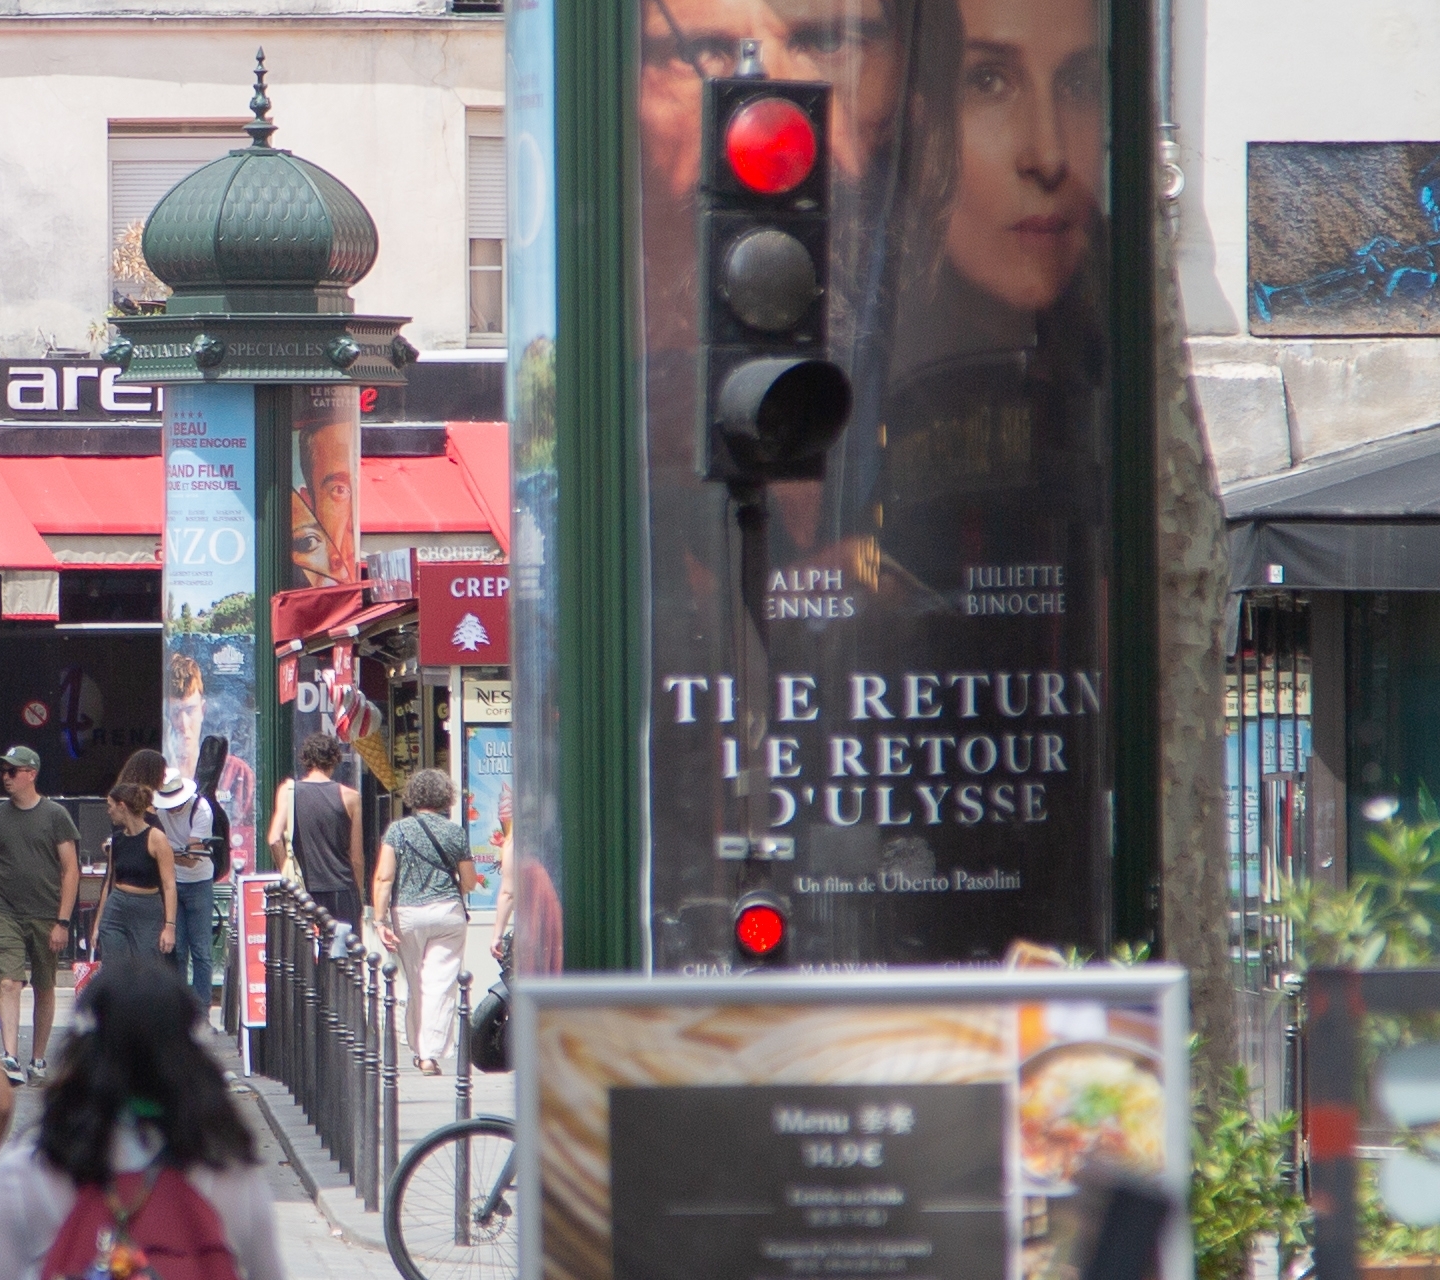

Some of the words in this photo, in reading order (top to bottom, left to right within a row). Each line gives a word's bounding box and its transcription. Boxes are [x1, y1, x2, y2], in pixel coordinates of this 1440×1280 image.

[132, 343, 193, 359] SPECTACLES
[227, 343, 324, 358] SPECTACLES
[173, 422, 207, 436] BEAU
[199, 438, 247, 449] ENCORE
[198, 464, 235, 478] FILM
[191, 481, 241, 491] SENSUEL
[968, 566, 1065, 591] JULIETTE
[966, 593, 1066, 616] BINOCHE
[850, 670, 1102, 720] RETURN
[829, 732, 1069, 777] RETOUR
[797, 877, 821, 894] Un
[825, 876, 855, 894] film
[858, 877, 877, 893] de
[881, 871, 950, 893] Uberto
[955, 868, 1022, 891] Pasolini
[773, 1103, 850, 1135] Menu
